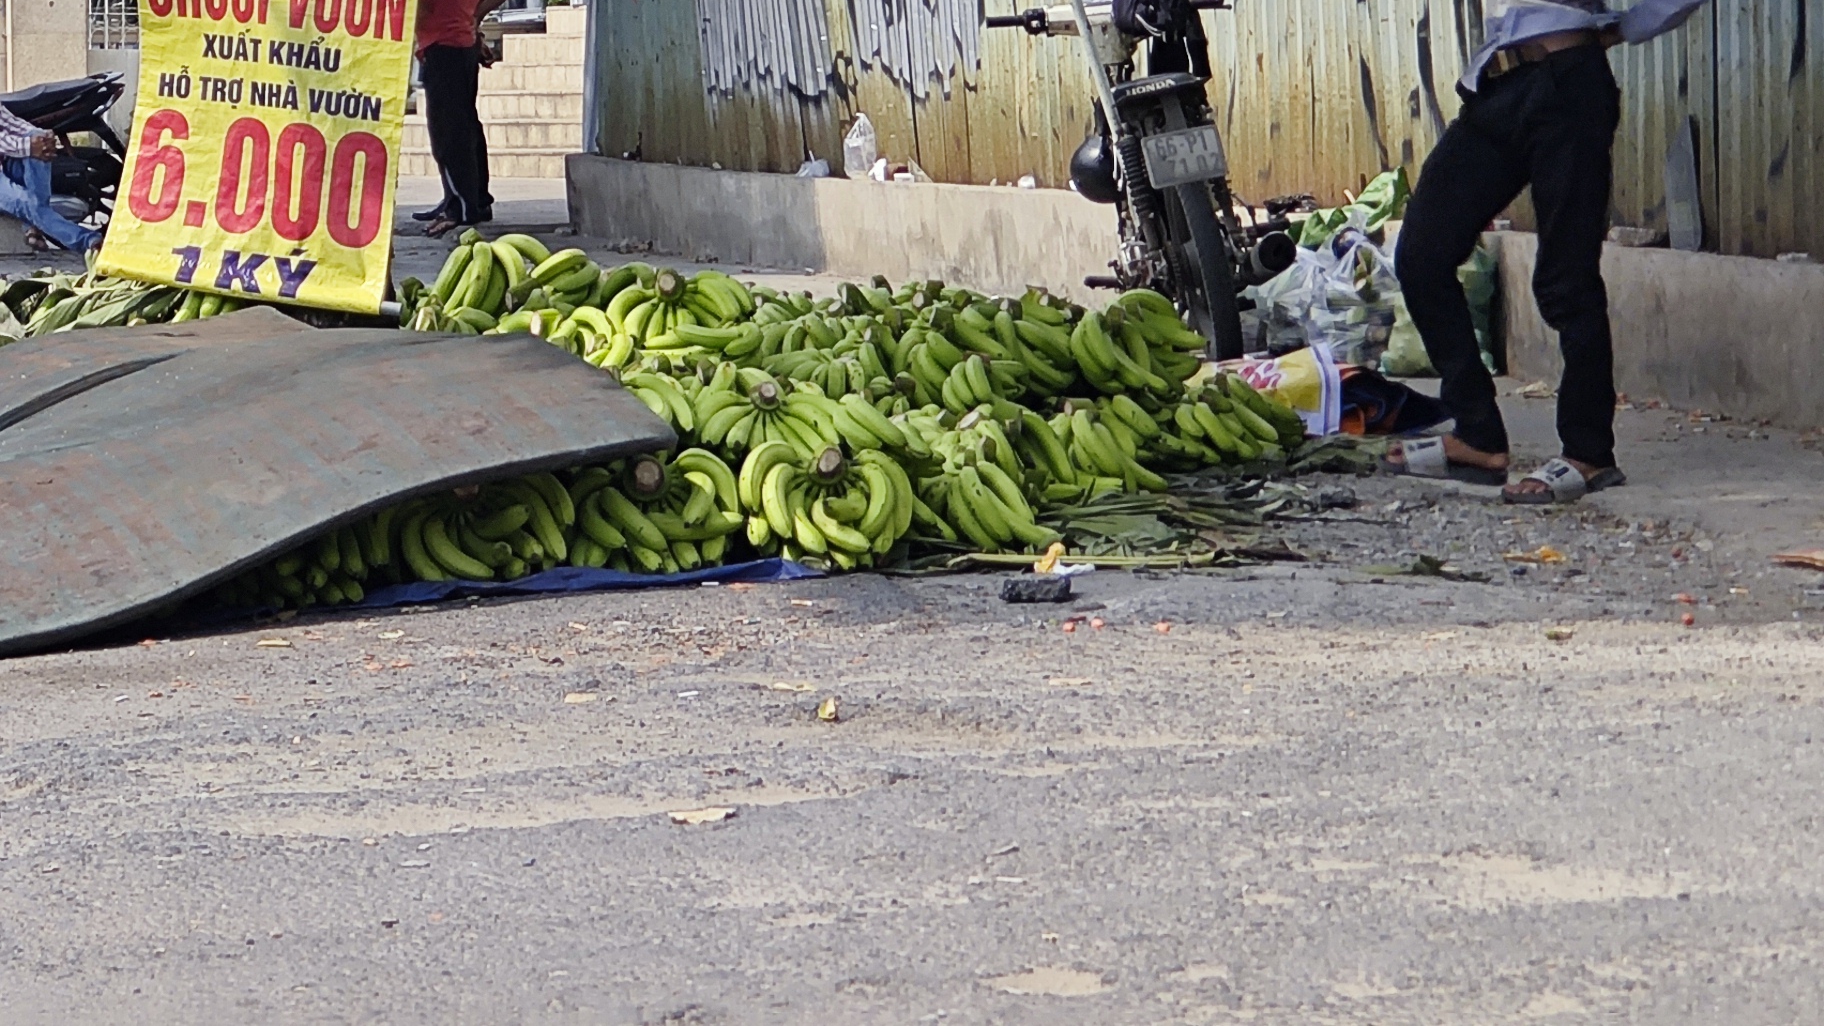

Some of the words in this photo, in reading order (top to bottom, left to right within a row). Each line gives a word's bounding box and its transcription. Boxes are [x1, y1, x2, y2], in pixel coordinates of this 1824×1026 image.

[202, 28, 262, 63] XUẤT
[268, 35, 342, 73] KHẨU
[158, 65, 192, 99] HỖ
[198, 76, 245, 110] TRỢ
[250, 79, 299, 111] NHÀ
[308, 86, 382, 122] VƯỜN
[1125, 78, 1176, 96] HONDA
[128, 108, 388, 249] 6.000
[171, 245, 202, 284] 1
[213, 248, 318, 299] KÝ
